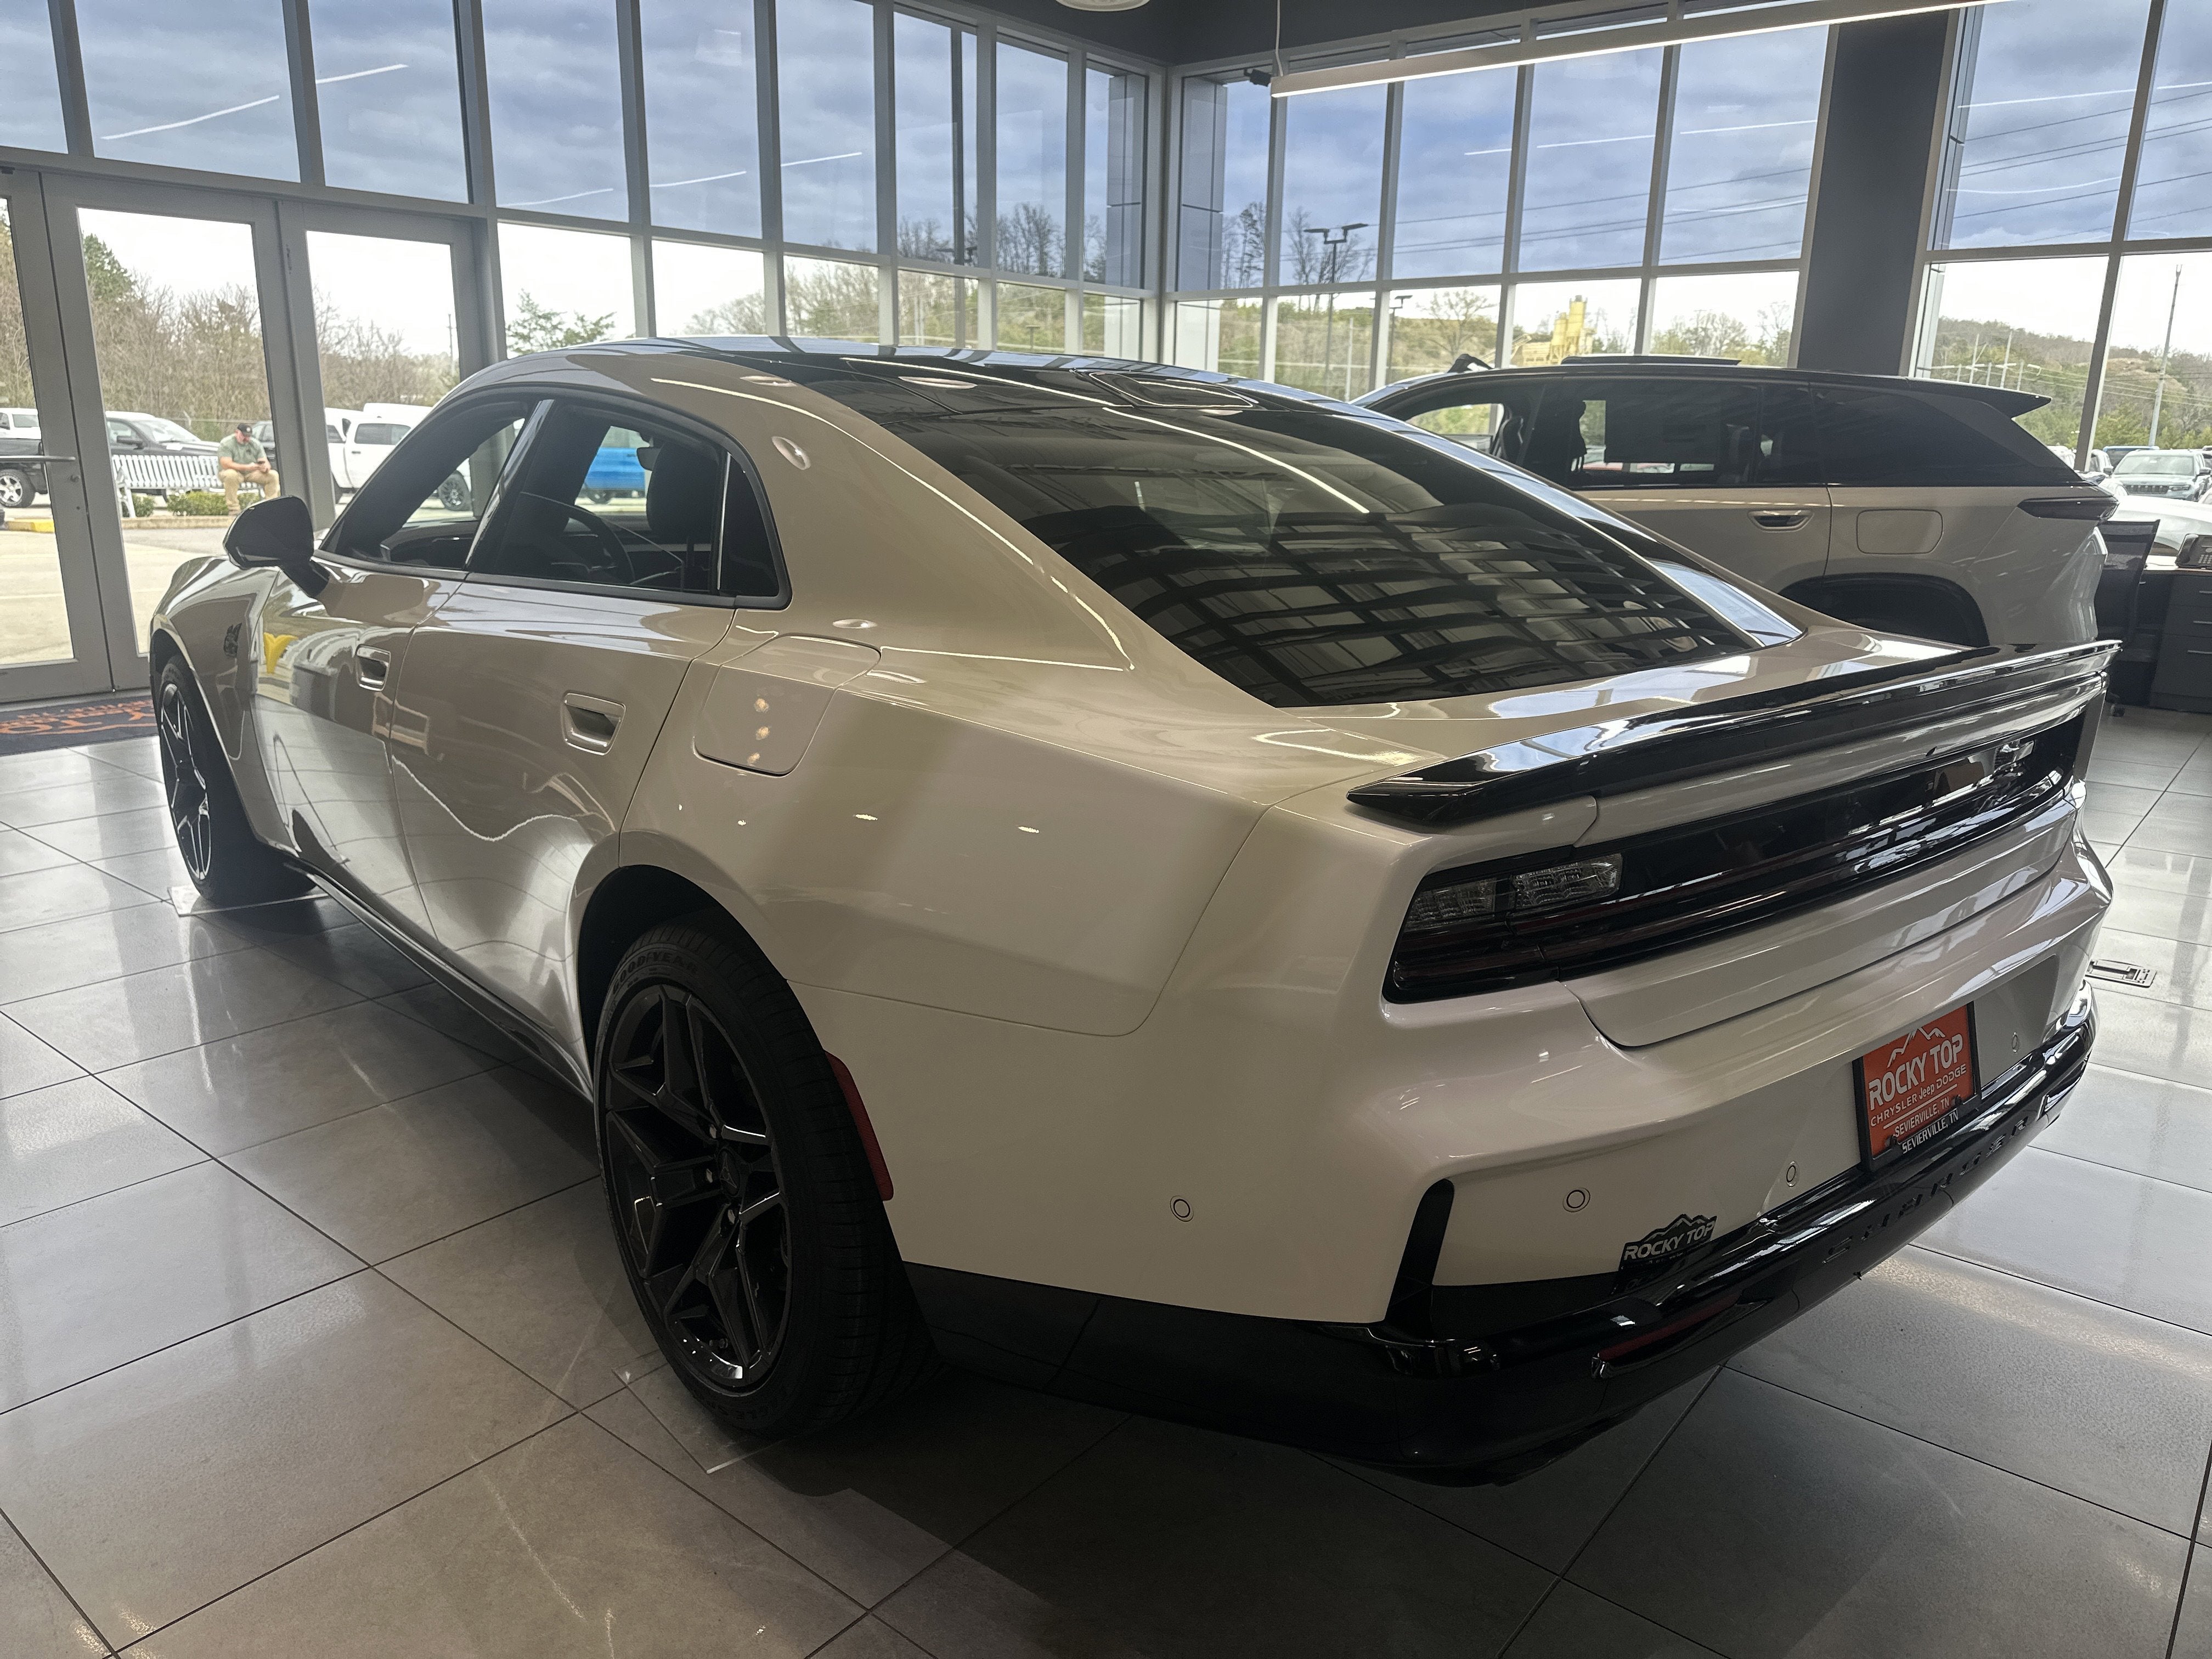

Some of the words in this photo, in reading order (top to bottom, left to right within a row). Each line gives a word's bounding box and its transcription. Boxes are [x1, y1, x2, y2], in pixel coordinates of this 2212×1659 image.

[1869, 1052, 1927, 1111] ROCKY
[1929, 1034, 1963, 1074] TOP
[1870, 1094, 1918, 1127] CHRYSLER
[1919, 1084, 1934, 1100] Jeep
[1936, 1063, 1967, 1090] DODGE
[1894, 1103, 1940, 1138] SEVIERVILLE,
[1940, 1097, 1950, 1110] TN
[1902, 1118, 1949, 1154] SEVIERVILLE,
[1949, 1109, 1959, 1124] TN
[1623, 1233, 1685, 1261] ROCKY
[1686, 1221, 1715, 1244] TOP
